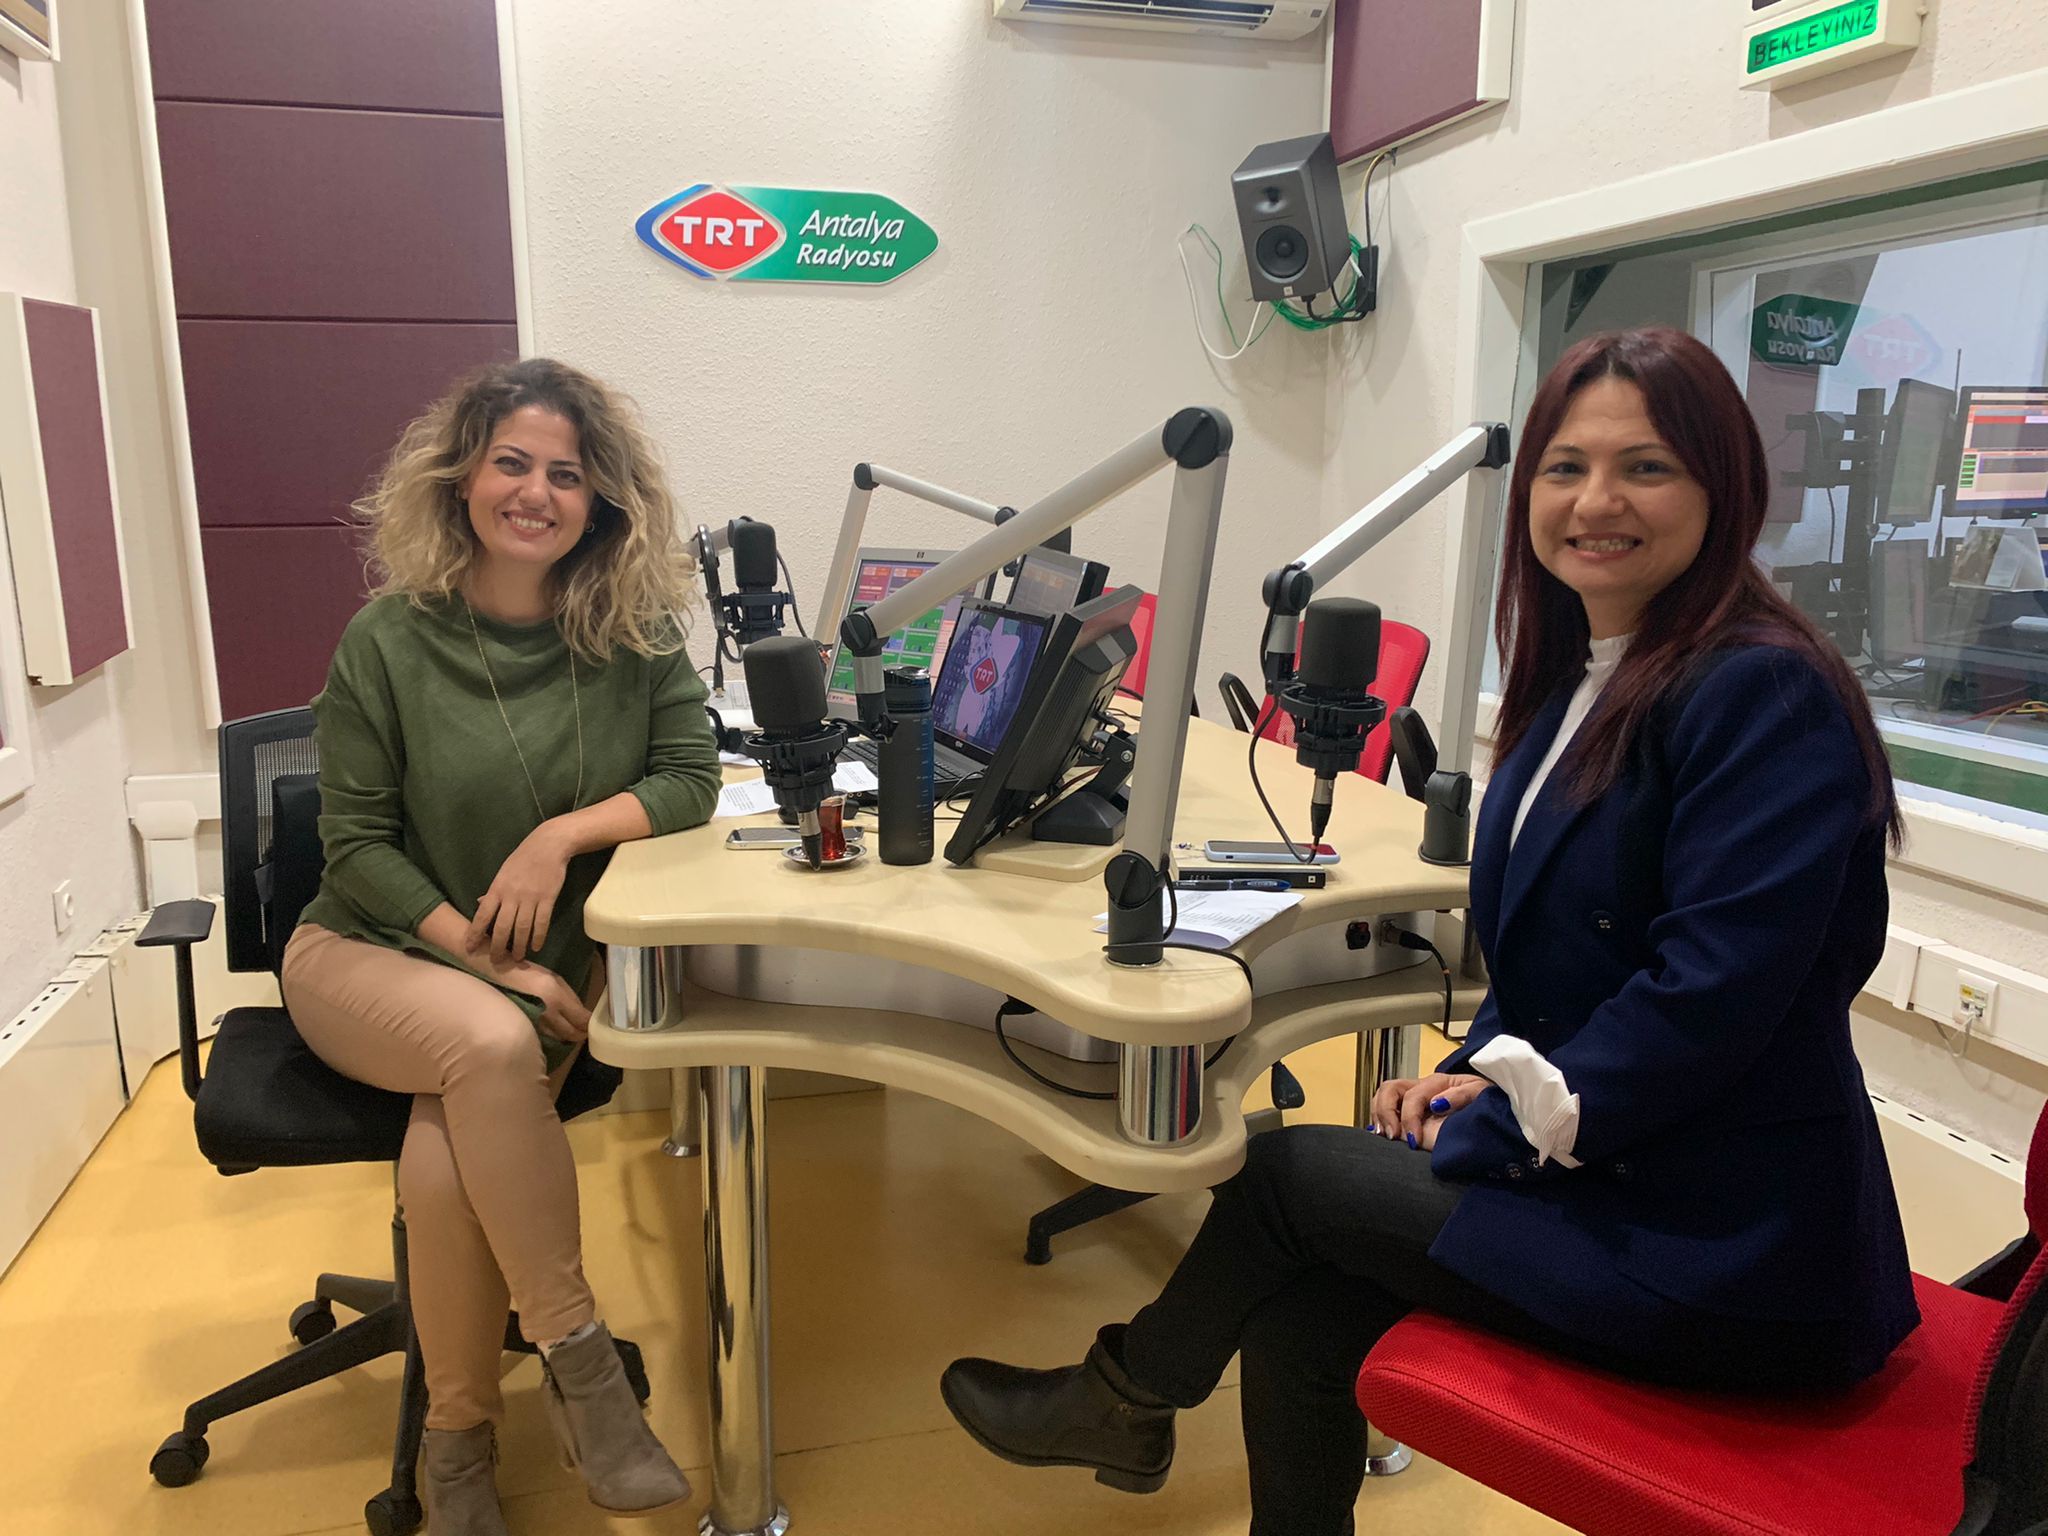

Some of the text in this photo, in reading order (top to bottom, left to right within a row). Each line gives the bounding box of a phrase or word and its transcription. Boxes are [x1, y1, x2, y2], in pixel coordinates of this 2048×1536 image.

[1754, 3, 1875, 66] BEKLEYİNİZ
[673, 215, 764, 247] TRT
[798, 209, 905, 244] Antalya
[796, 243, 897, 271] Radyosu
[975, 666, 994, 683] TRT
